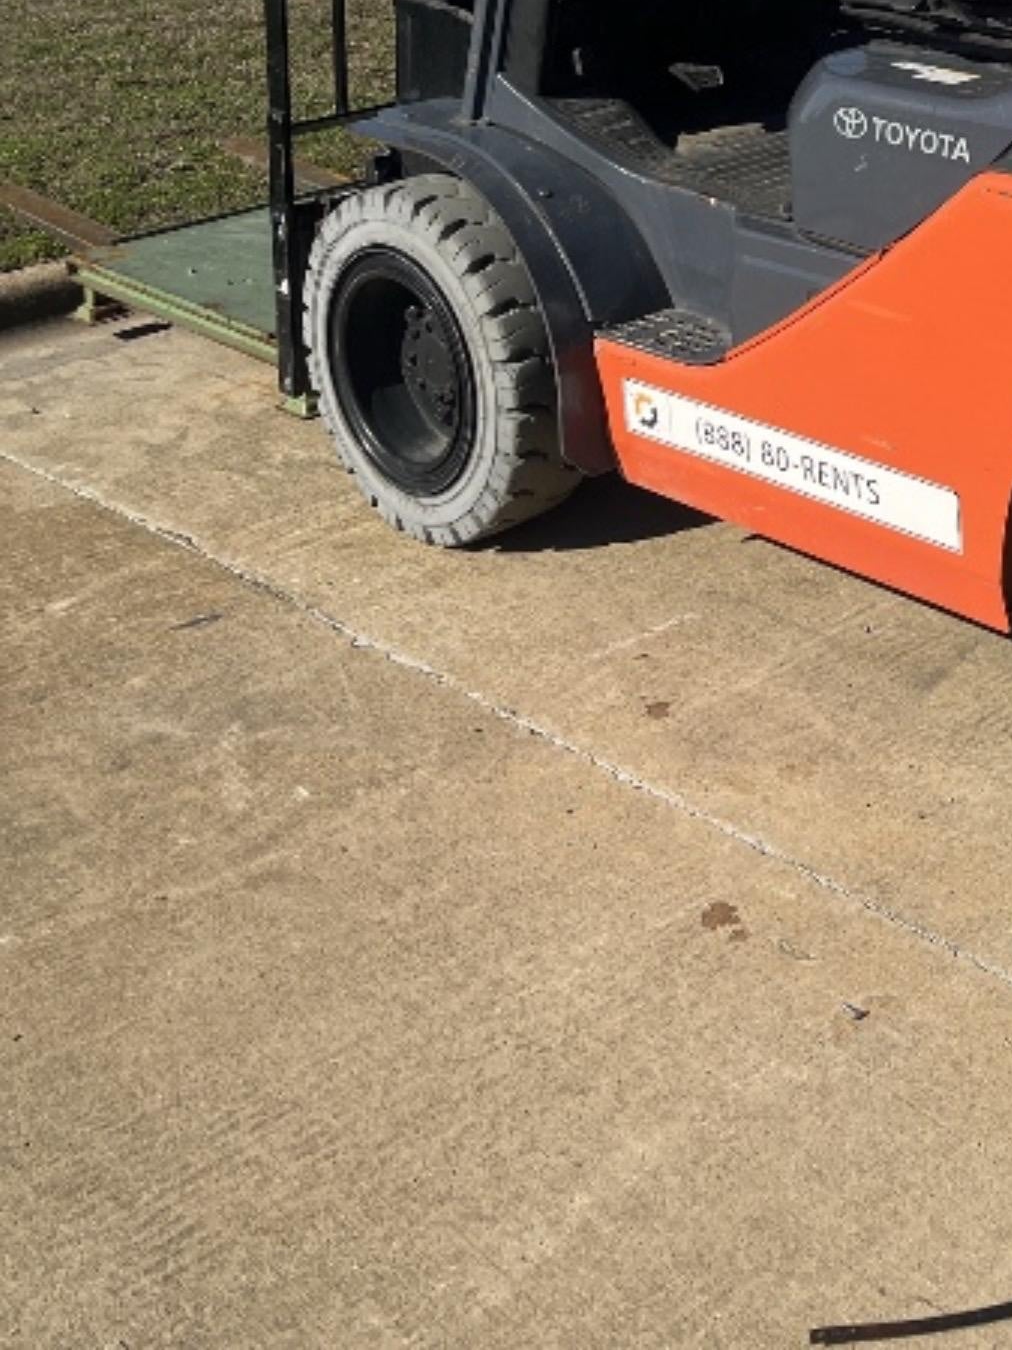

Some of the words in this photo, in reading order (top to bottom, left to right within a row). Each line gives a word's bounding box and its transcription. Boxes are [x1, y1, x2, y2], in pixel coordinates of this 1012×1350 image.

[872, 116, 970, 163] TOYOTA
[695, 416, 751, 462] (888)
[760, 440, 880, 505] 80-RENTS
